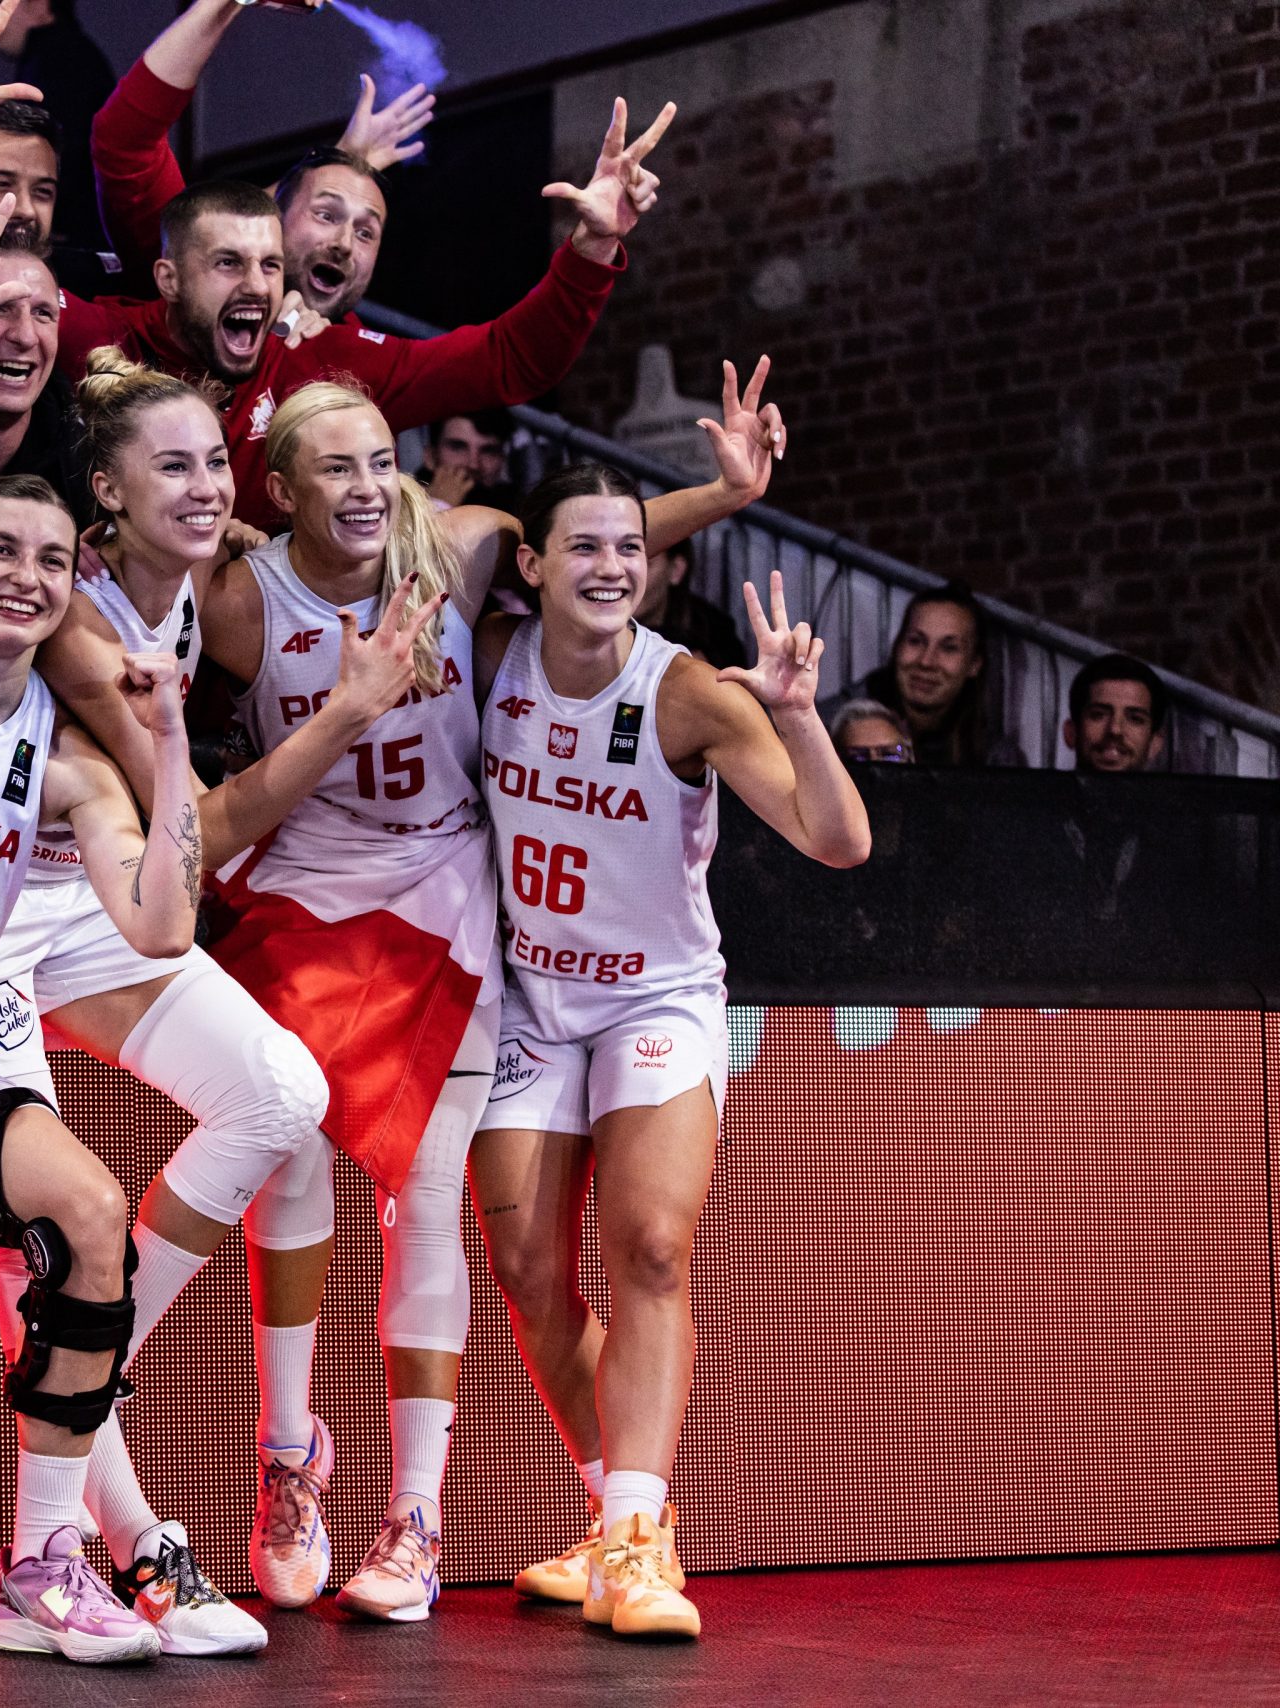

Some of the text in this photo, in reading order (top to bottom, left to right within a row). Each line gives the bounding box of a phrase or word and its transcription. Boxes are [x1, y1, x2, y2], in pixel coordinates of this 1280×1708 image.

[281, 628, 324, 655] 4F
[496, 695, 537, 720] 4F
[613, 737, 634, 749] FIBA
[347, 733, 426, 801] 15
[484, 748, 649, 822] POLSKA
[512, 834, 588, 915] 66
[515, 927, 645, 984] Energa
[496, 1053, 521, 1073] lski
